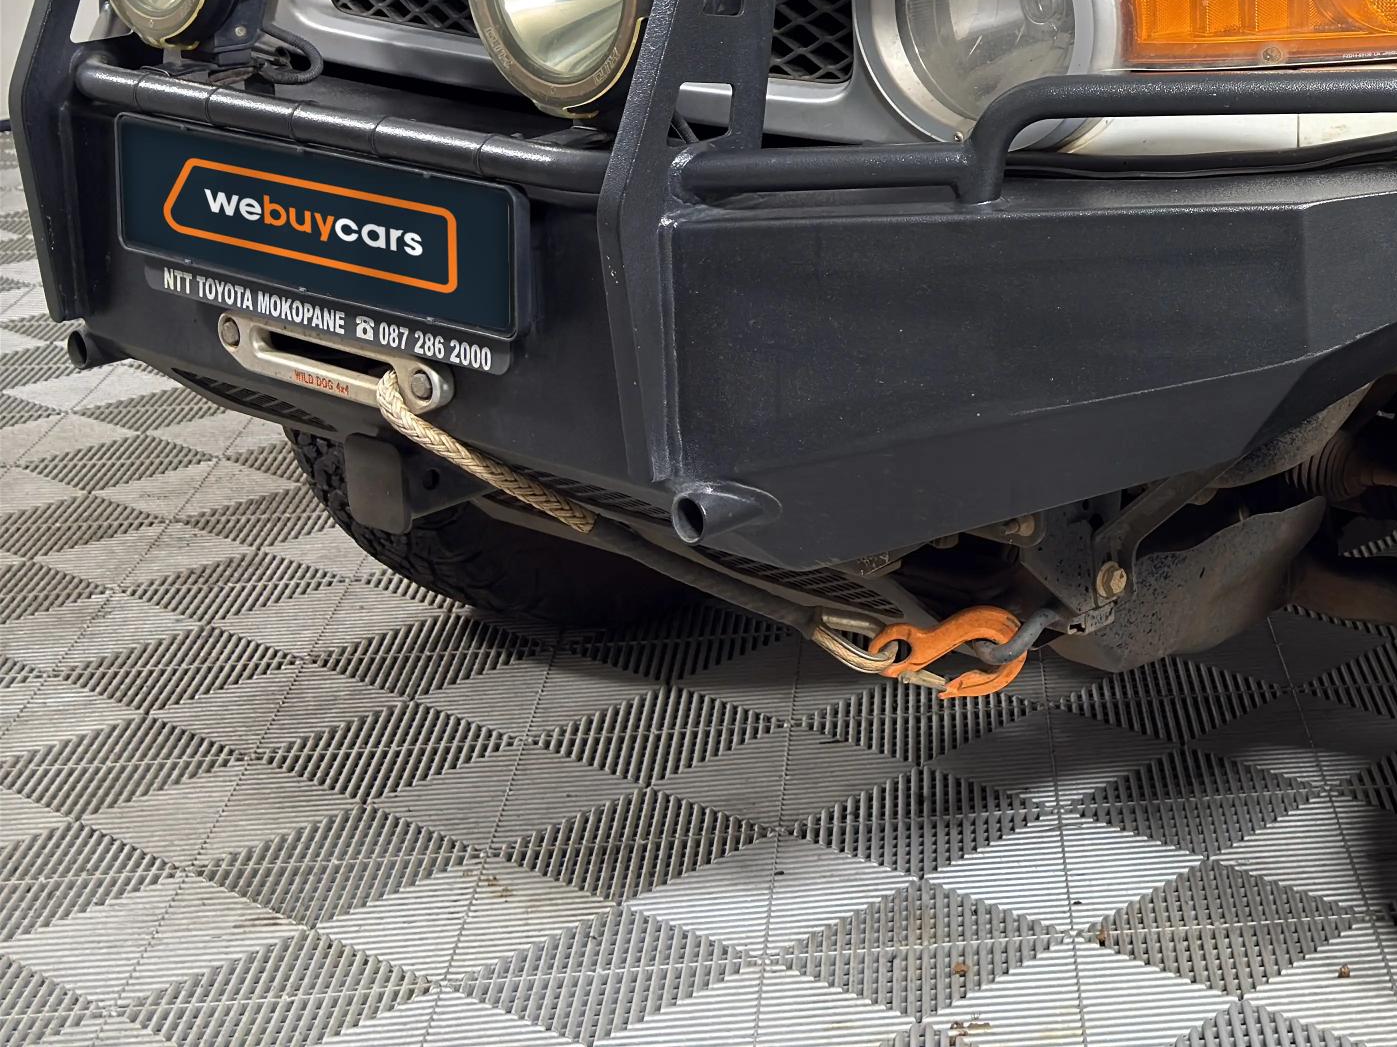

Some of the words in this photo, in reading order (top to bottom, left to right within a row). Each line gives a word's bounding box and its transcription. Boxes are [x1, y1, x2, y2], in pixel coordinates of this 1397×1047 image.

[203, 188, 424, 257] webuycars
[163, 267, 193, 295] NTT
[196, 275, 254, 311] TOYOTA
[257, 290, 346, 335] MOKOPANE
[379, 322, 409, 350] 087
[414, 330, 445, 359] 286
[449, 339, 492, 371] 2000
[294, 369, 314, 384] WILD
[315, 375, 334, 390] DOG
[335, 382, 350, 395] 4x4
